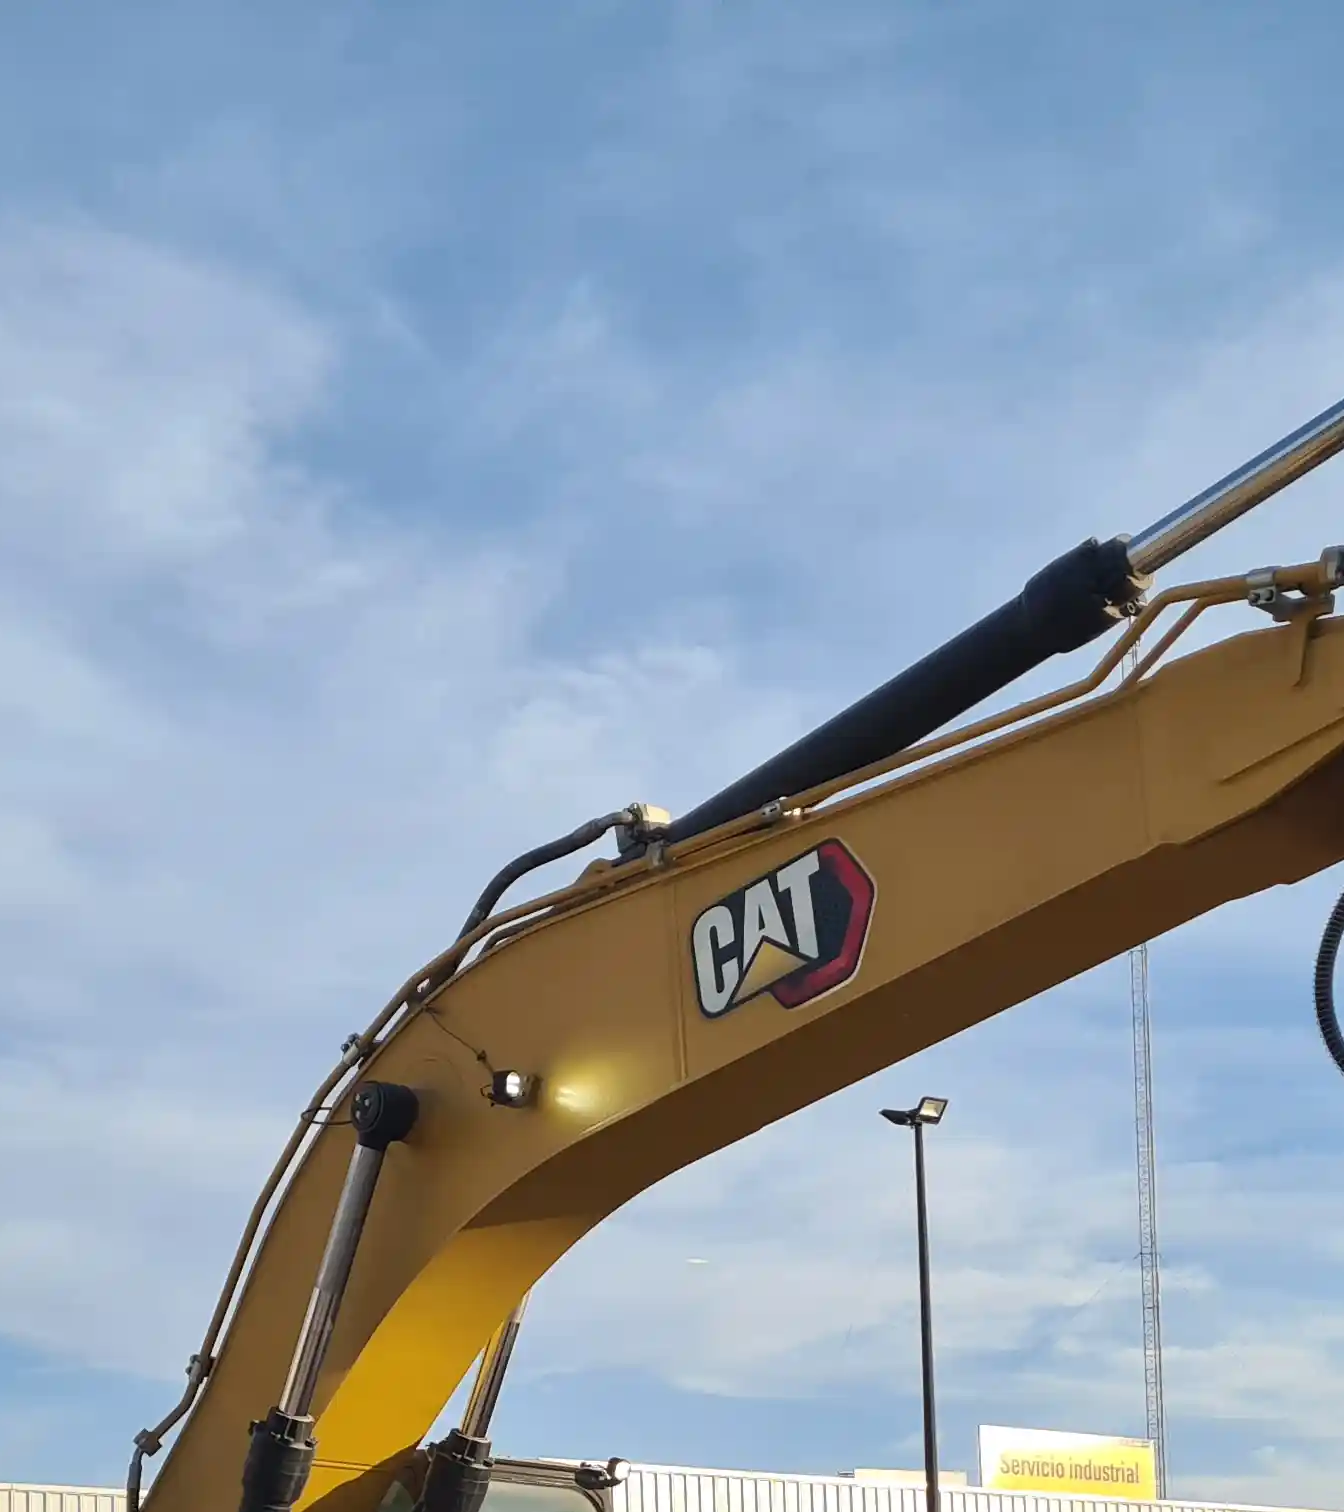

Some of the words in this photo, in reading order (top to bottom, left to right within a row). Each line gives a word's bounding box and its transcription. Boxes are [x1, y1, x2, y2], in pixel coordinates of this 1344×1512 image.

[692, 850, 821, 1014] CAT
[1000, 1454, 1065, 1479] Servicio
[1069, 1457, 1141, 1484] industrial
